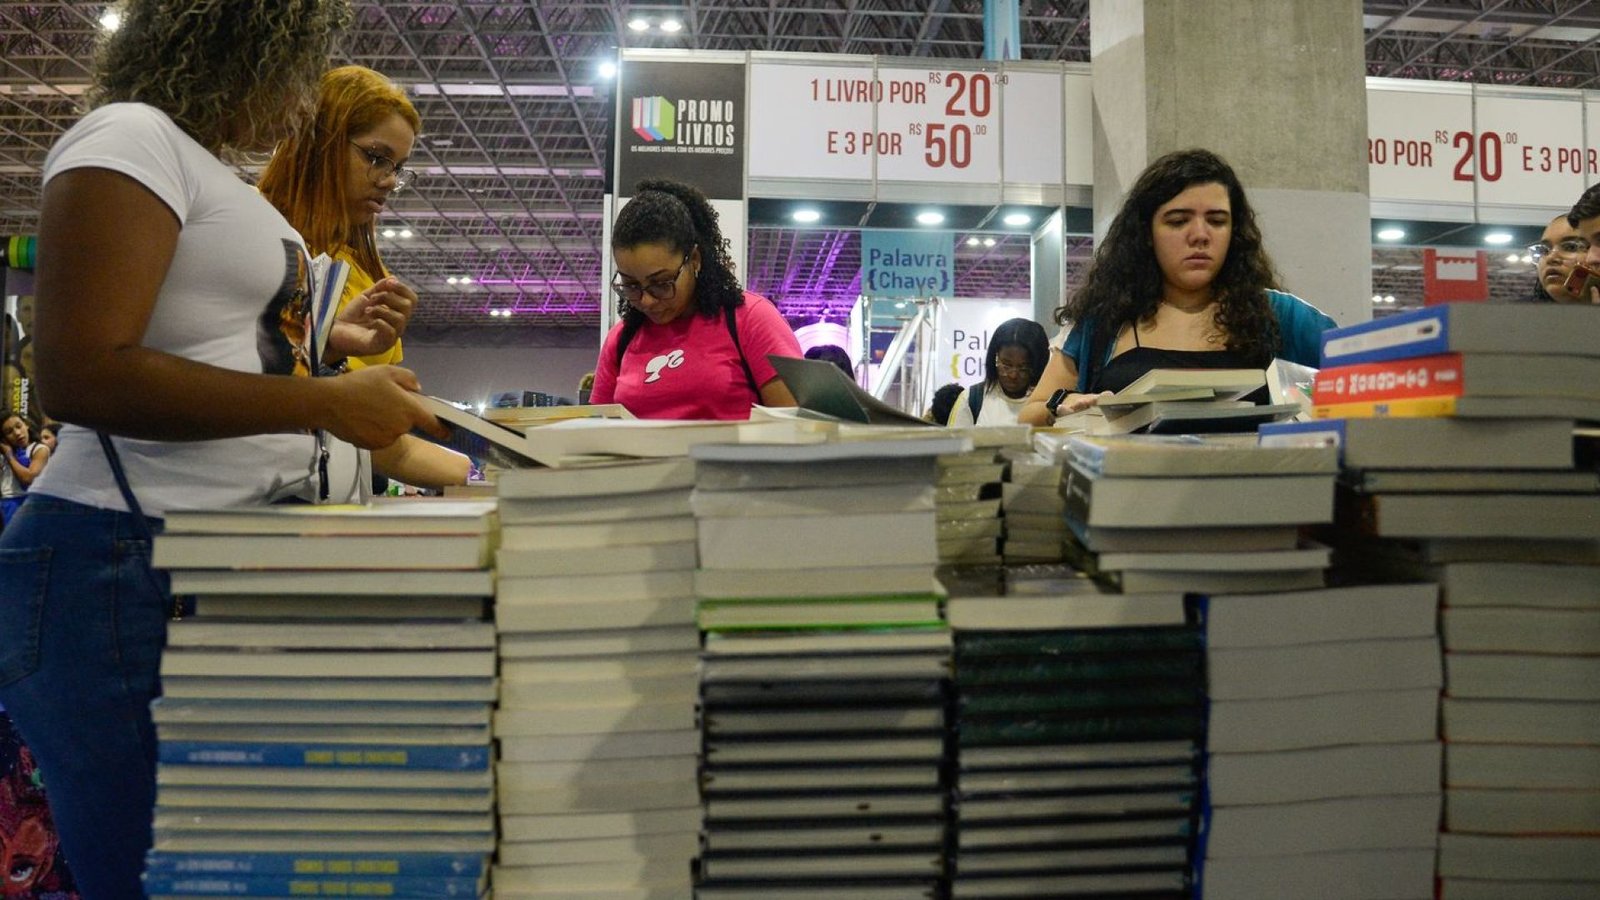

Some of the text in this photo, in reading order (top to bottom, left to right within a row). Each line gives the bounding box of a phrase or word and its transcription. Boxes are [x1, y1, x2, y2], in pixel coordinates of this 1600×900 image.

[811, 80, 818, 101] 1
[826, 79, 883, 103] LIVRO
[890, 81, 926, 104] POR
[945, 72, 991, 118] 20
[677, 99, 734, 122] PROMO
[677, 123, 734, 146] LIVROS
[827, 123, 987, 168] E 3 POR R$ 50 .00
[1394, 140, 1433, 167] POR
[1453, 131, 1503, 182] 20
[1503, 132, 1518, 144] .00
[1523, 146, 1534, 171] E
[1540, 147, 1552, 172] 3
[1558, 147, 1598, 174] POR
[870, 248, 947, 267] Palavra
[868, 268, 950, 292] {Chave}
